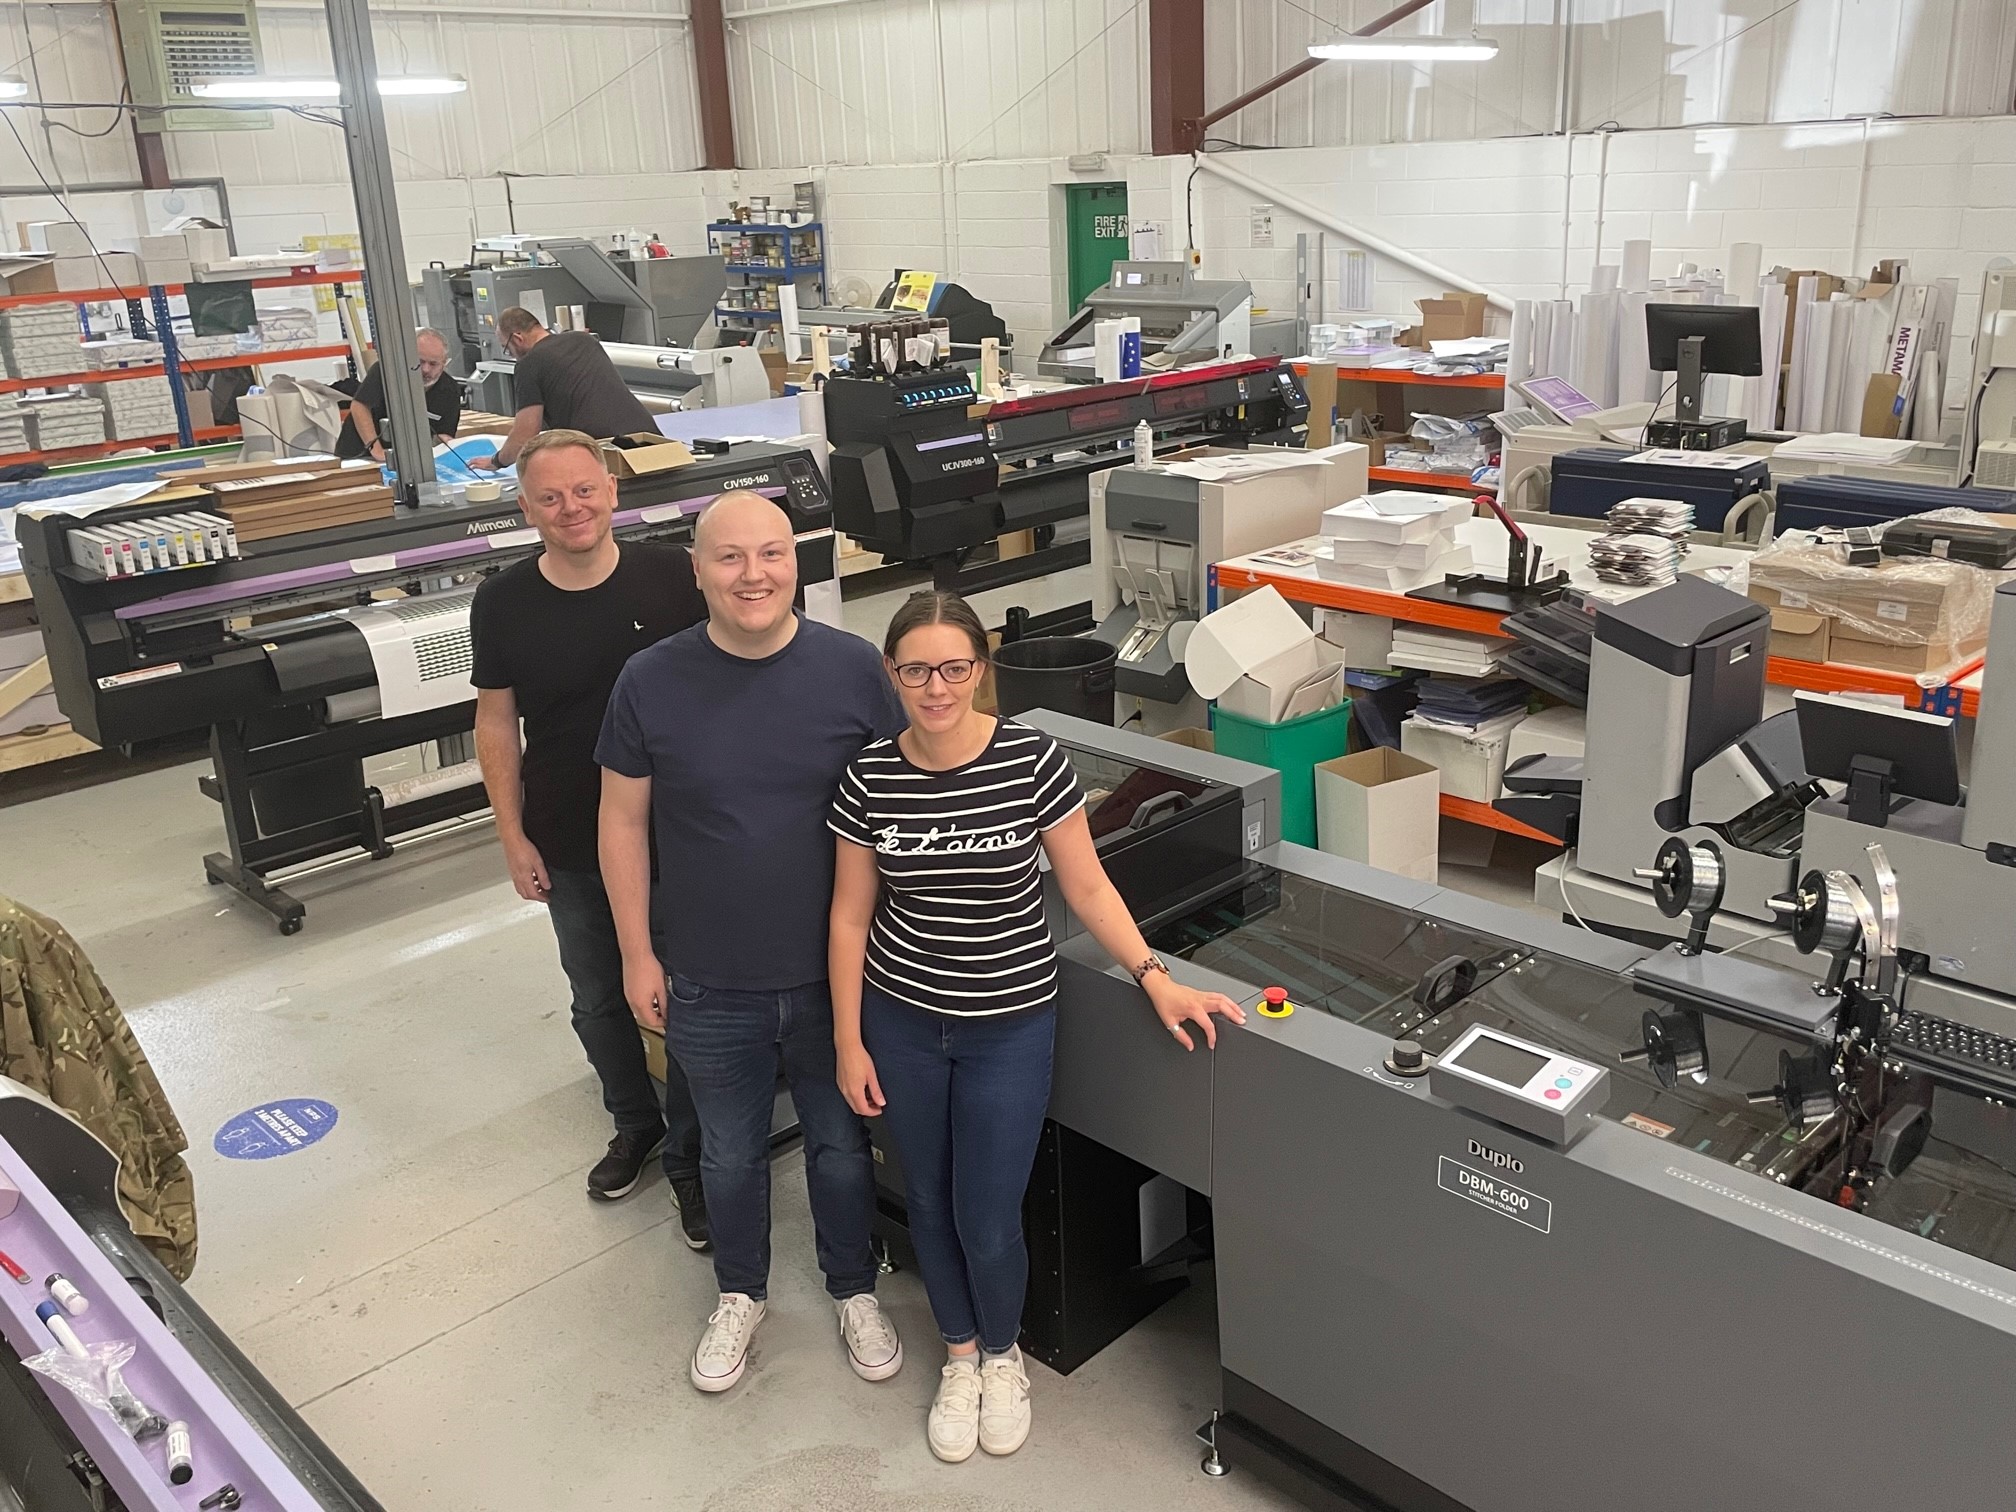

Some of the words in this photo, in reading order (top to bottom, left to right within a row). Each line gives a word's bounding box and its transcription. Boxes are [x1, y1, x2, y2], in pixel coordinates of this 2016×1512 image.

[1094, 215, 1116, 227] FIRE
[1094, 226, 1115, 238] EXIT
[941, 456, 986, 472] UCJV300-160
[723, 474, 770, 490] CJV150-160
[257, 1112, 285, 1132] METRES
[277, 1129, 303, 1147] APART
[270, 1108, 297, 1127] PLEASE
[288, 1124, 309, 1137] KEEP
[1467, 1138, 1525, 1174] Duplo
[1459, 1169, 1529, 1211] DBM-600
[1468, 1189, 1495, 1205] STITCHER
[1495, 1200, 1518, 1215] FOLDER
